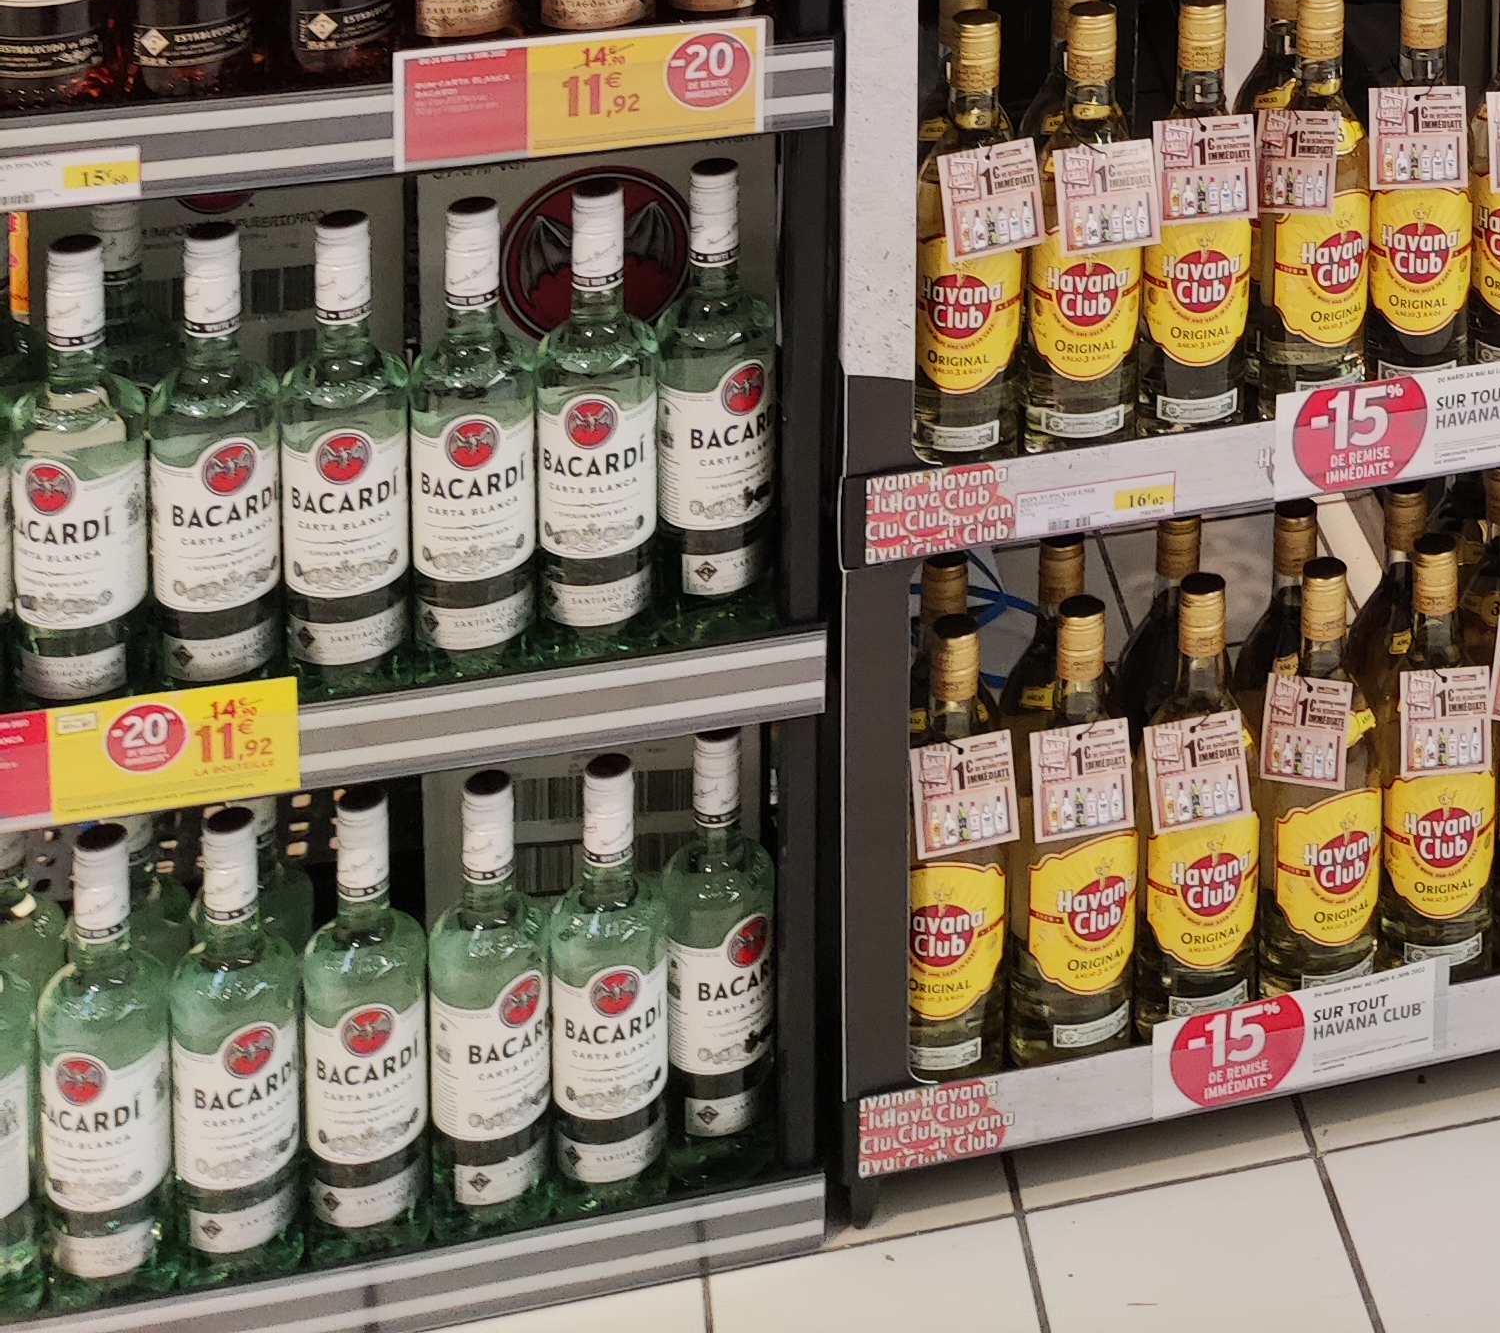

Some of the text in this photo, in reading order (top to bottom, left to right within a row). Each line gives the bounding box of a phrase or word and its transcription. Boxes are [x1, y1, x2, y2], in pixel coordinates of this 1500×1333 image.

[1382, 224, 1458, 250] Havana
[1395, 253, 1443, 274] Club
[1436, 393, 1466, 410] SUR
[1435, 407, 1500, 430] HAVANA
[543, 435, 646, 477] BACARDÍ
[421, 454, 526, 500] BACARDÍ
[291, 470, 399, 514] BACARDÍ
[1405, 807, 1483, 835] Havana
[1420, 838, 1469, 860] Club
[565, 994, 664, 1045] BACARDÍ
[1313, 995, 1389, 1023] SUR TOUT
[1313, 1015, 1377, 1040] HAVANA
[316, 1038, 421, 1085] BACARDÍ
